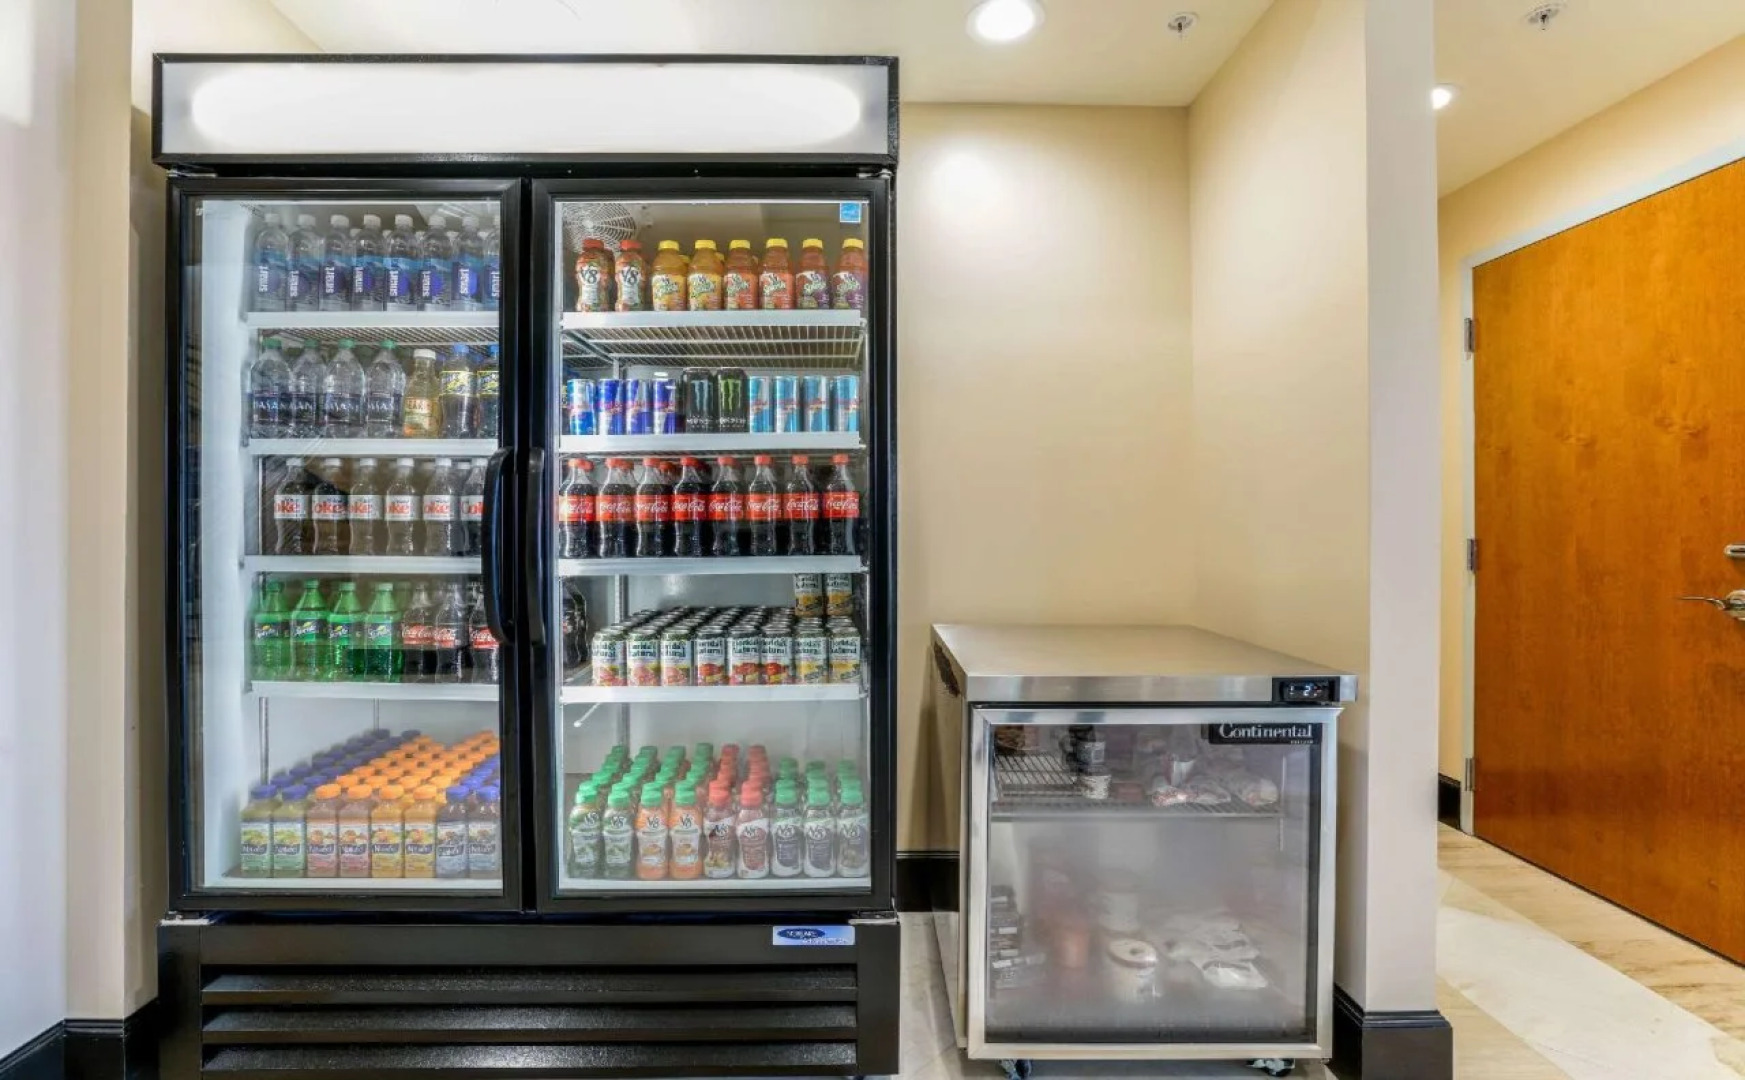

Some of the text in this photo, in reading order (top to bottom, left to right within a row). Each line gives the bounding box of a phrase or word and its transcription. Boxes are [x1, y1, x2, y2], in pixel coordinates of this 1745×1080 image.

[581, 267, 598, 285] V8
[621, 266, 639, 286] V8
[1219, 722, 1314, 738] Continental
